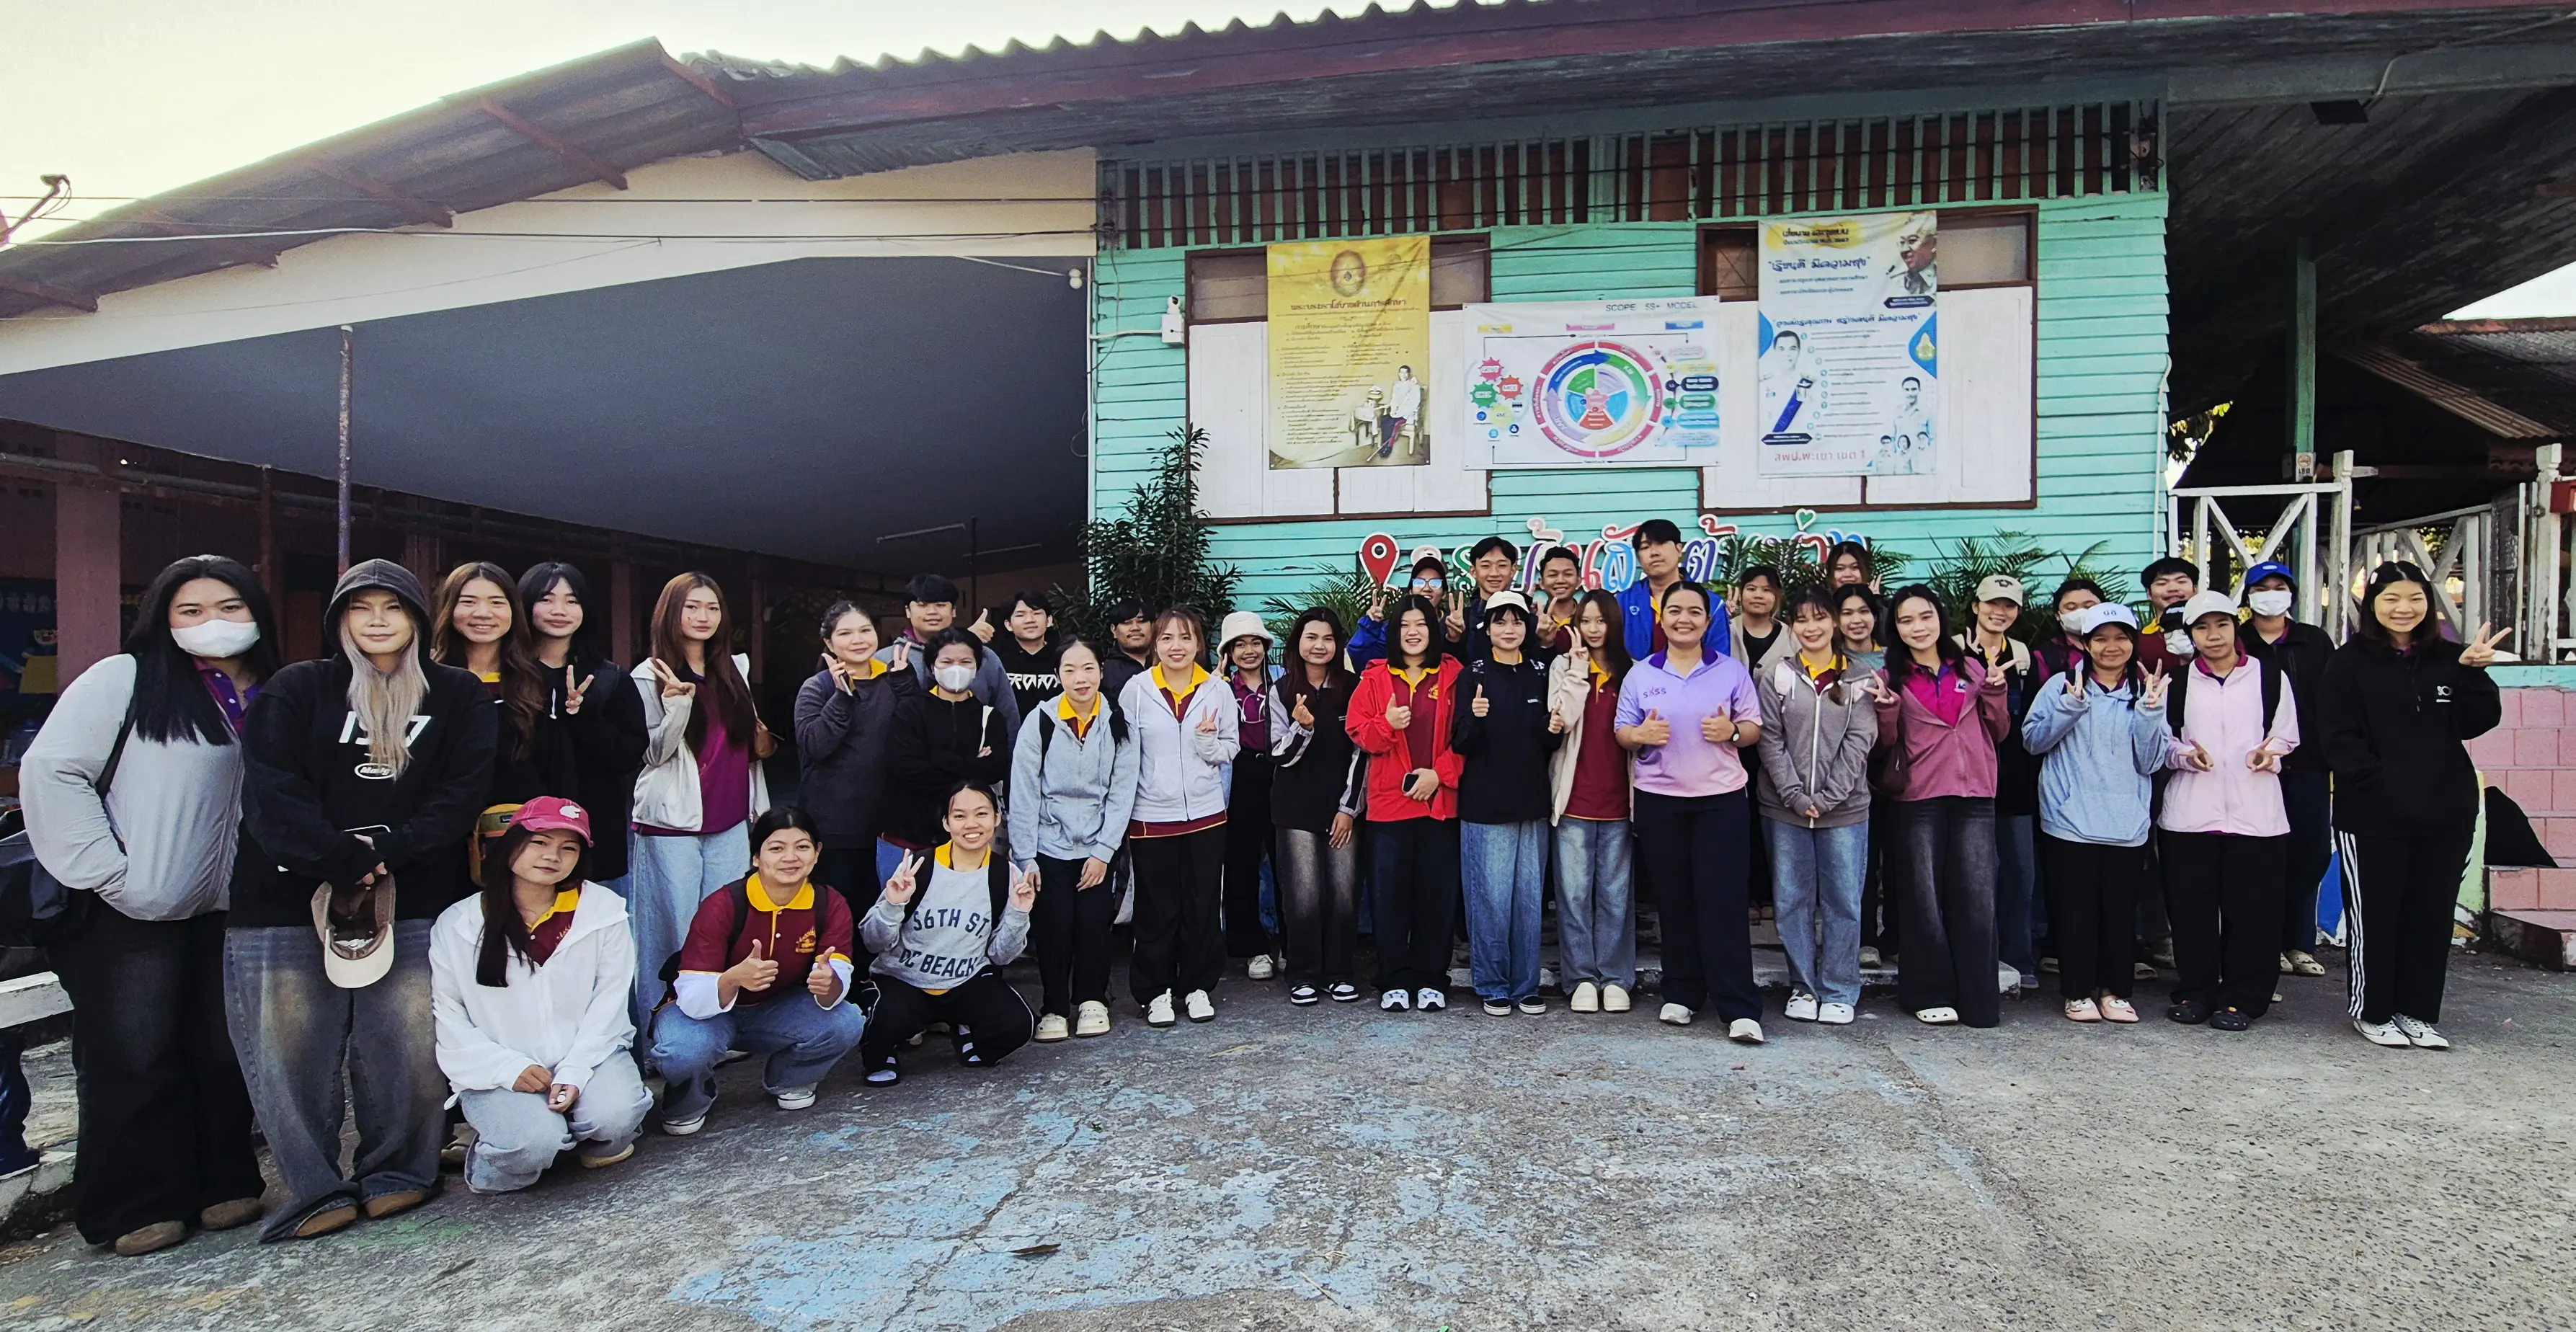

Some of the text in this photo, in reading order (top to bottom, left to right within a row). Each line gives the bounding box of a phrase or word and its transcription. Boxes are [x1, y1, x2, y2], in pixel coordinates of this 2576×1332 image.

[1606, 303, 1636, 312] SCOPE
[912, 908, 990, 939] 56TH ST.
